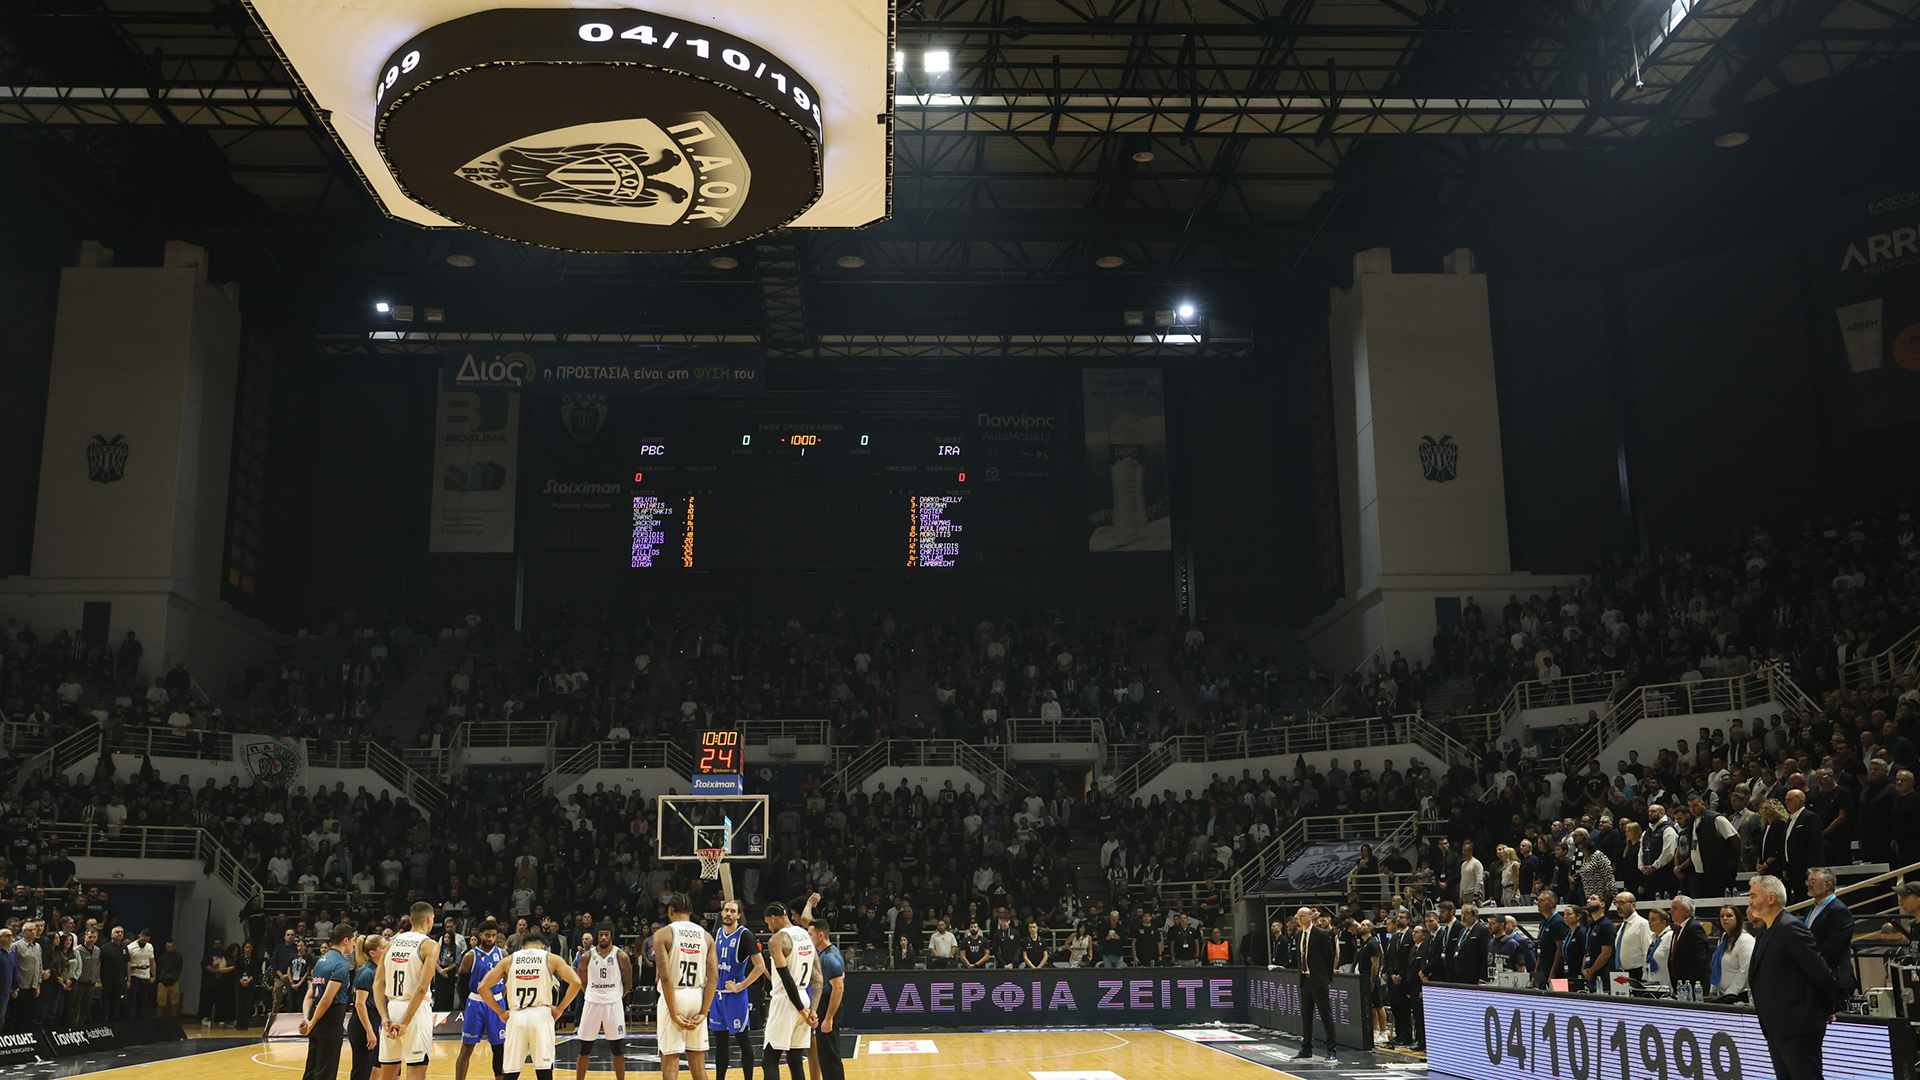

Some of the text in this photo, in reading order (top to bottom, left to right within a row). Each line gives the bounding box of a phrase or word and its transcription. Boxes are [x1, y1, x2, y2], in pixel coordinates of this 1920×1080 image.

[480, 159, 510, 191] 1926
[1840, 224, 1920, 271] ARR
[456, 353, 755, 387] Διός η ΠΡΟΣΤΑΣΙΑ είναι στη ΦΥΣΗ του
[978, 413, 1055, 430] Γιαννίρης
[445, 434, 507, 442] BIOCLIMA
[742, 434, 750, 446] 0
[860, 434, 869, 446] 0
[982, 431, 1051, 443] AutoMobility
[641, 445, 665, 455] PBC
[937, 445, 961, 456] IRA
[634, 472, 642, 483] 0
[958, 472, 966, 483] 0
[543, 479, 621, 494] Stoiximan
[552, 501, 581, 509] Μεγάλος
[702, 731, 738, 746] 10:00
[700, 748, 733, 769] 24
[693, 779, 736, 788] Stoiximan
[679, 929, 702, 939] MOORE
[721, 947, 728, 958] 11
[516, 956, 542, 964] BROWN
[600, 968, 607, 978] 16
[678, 961, 697, 987] 26
[799, 962, 808, 987] 2
[393, 970, 405, 996] 18
[862, 979, 1234, 1013] ΑΔΕΡΦΙΑ ΖΕΙΤΕ
[52, 1028, 90, 1046] Γιαννίρης
